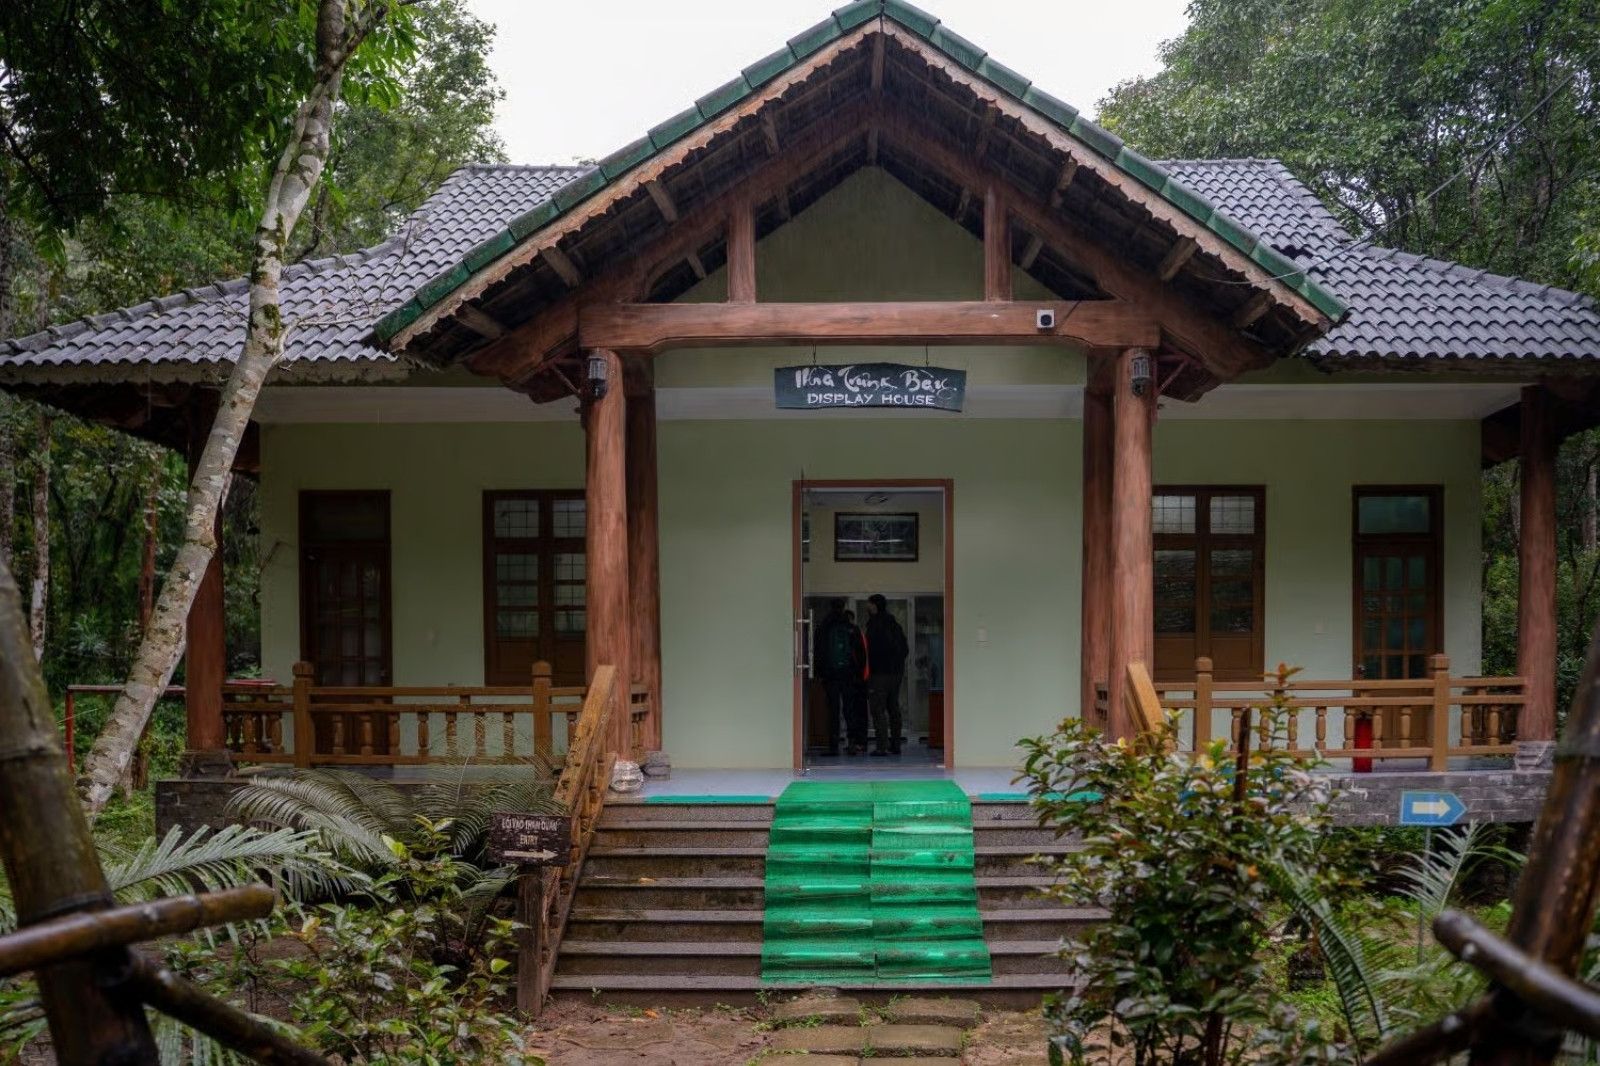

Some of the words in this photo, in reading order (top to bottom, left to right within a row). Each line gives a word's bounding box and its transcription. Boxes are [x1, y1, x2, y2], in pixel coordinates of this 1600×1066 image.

[807, 393, 873, 404] DISPLAY
[881, 394, 935, 405] HOUSE
[520, 834, 538, 845] ENTRY
